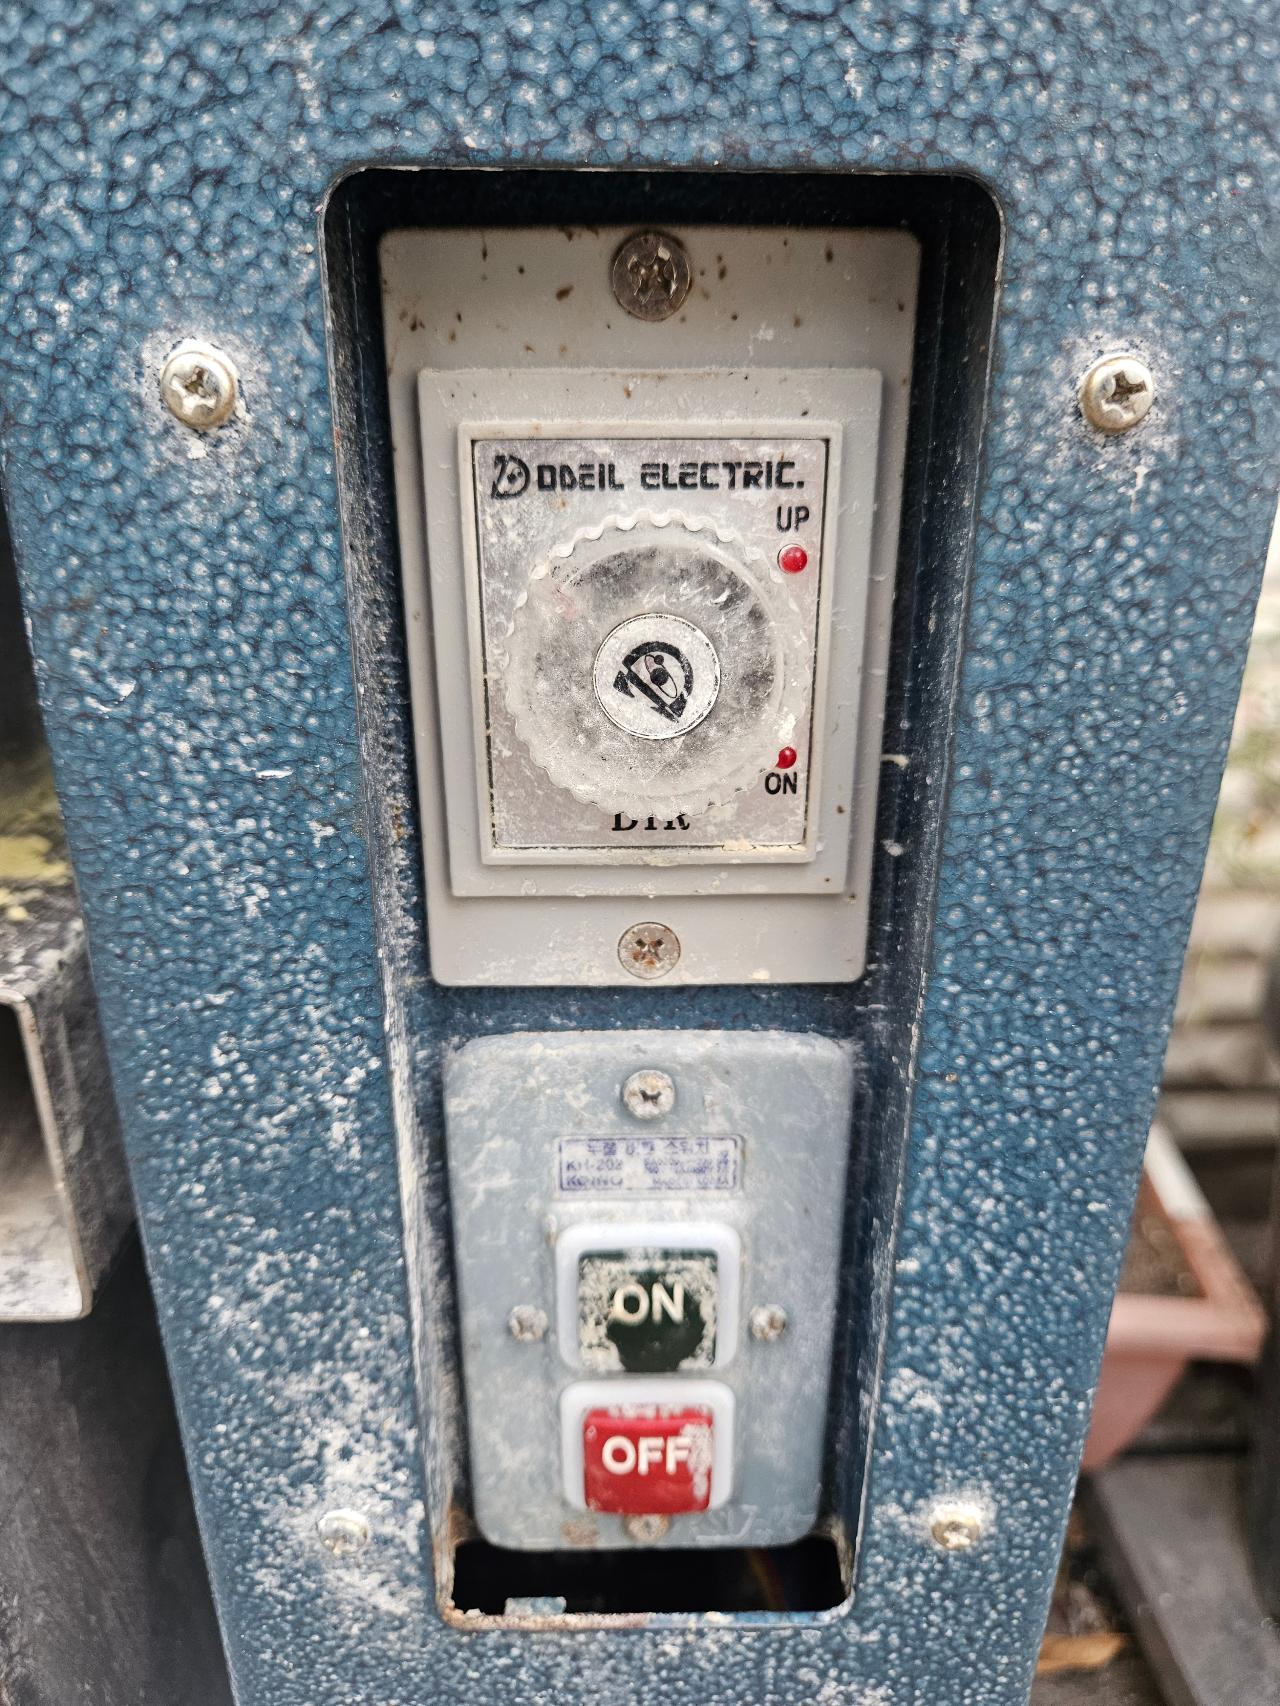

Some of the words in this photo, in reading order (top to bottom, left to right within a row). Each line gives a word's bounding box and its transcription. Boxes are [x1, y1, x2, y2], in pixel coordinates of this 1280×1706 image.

[776, 506, 810, 533] UP
[764, 772, 798, 795] ON
[612, 1282, 684, 1325] ON
[602, 1435, 692, 1476] OFF
